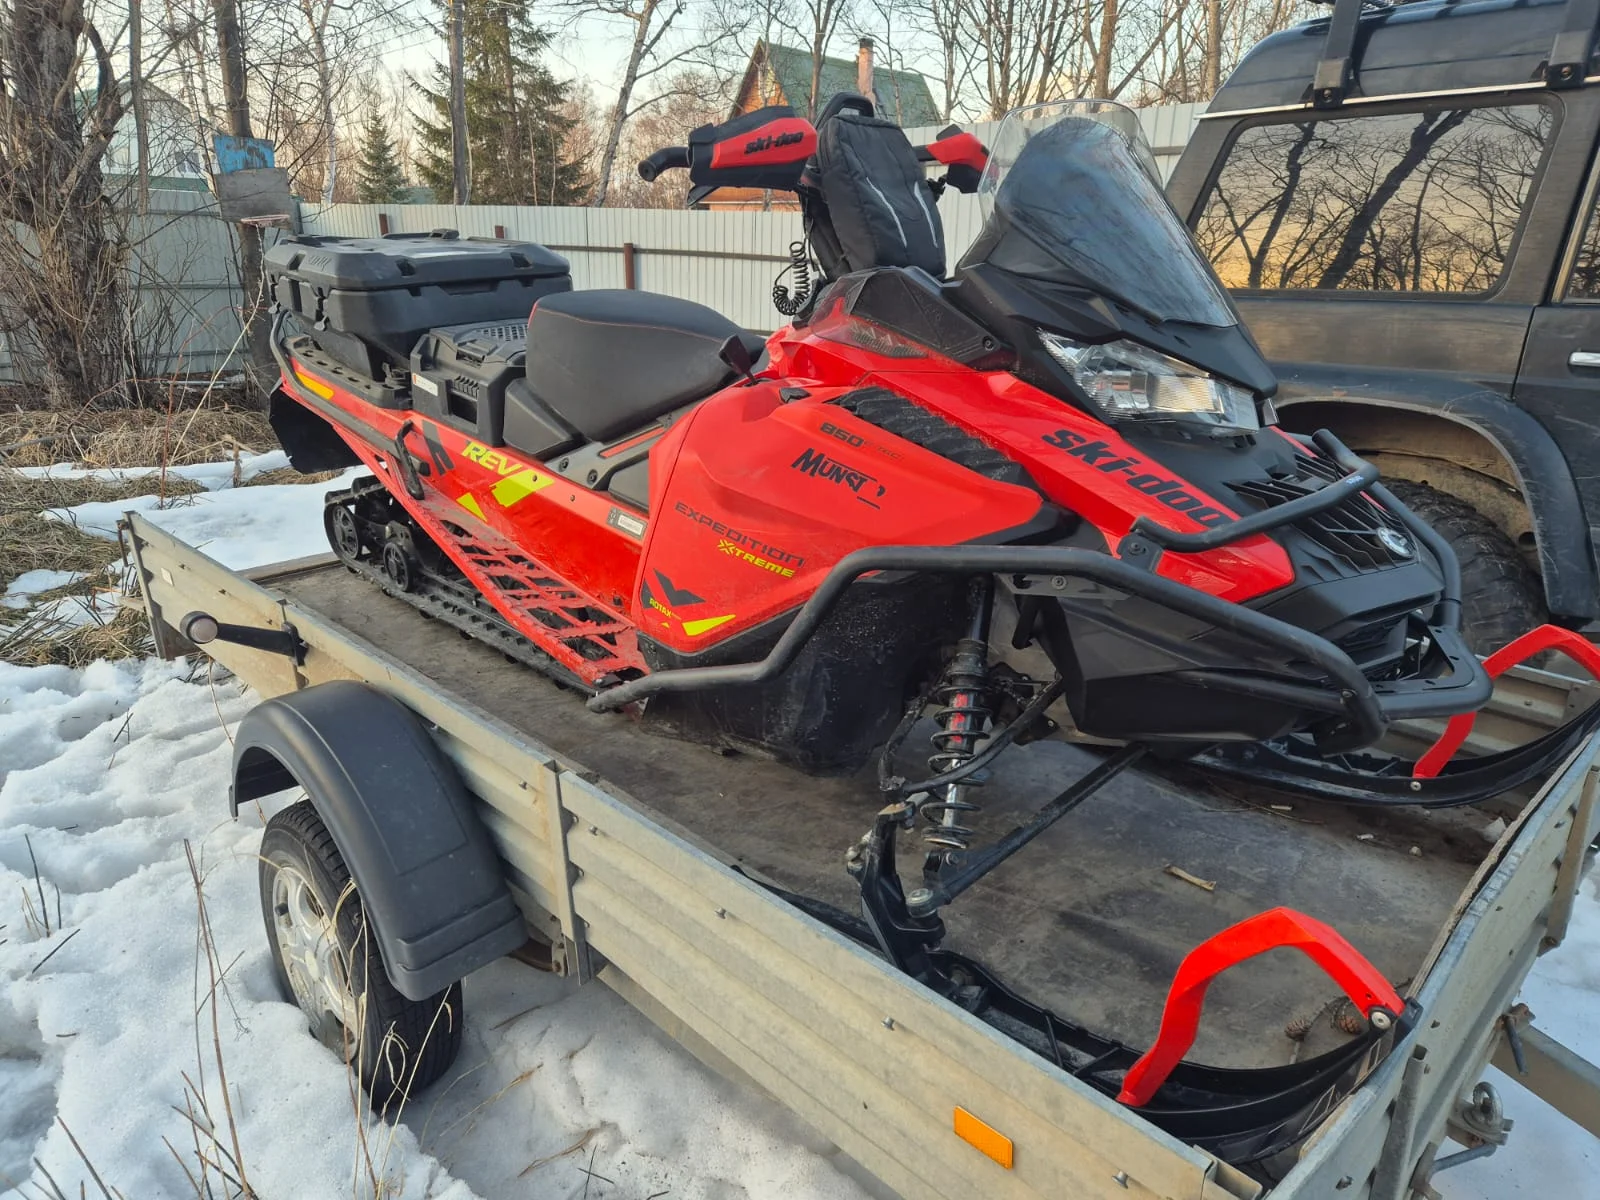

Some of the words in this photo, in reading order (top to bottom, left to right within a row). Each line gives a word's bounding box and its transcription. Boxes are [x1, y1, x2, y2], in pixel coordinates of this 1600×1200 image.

[820, 422, 865, 448] 850
[461, 441, 524, 477] REV
[674, 501, 805, 567] EXPEDITION
[717, 539, 796, 578] XTREME
[649, 597, 672, 617] ROTAX
